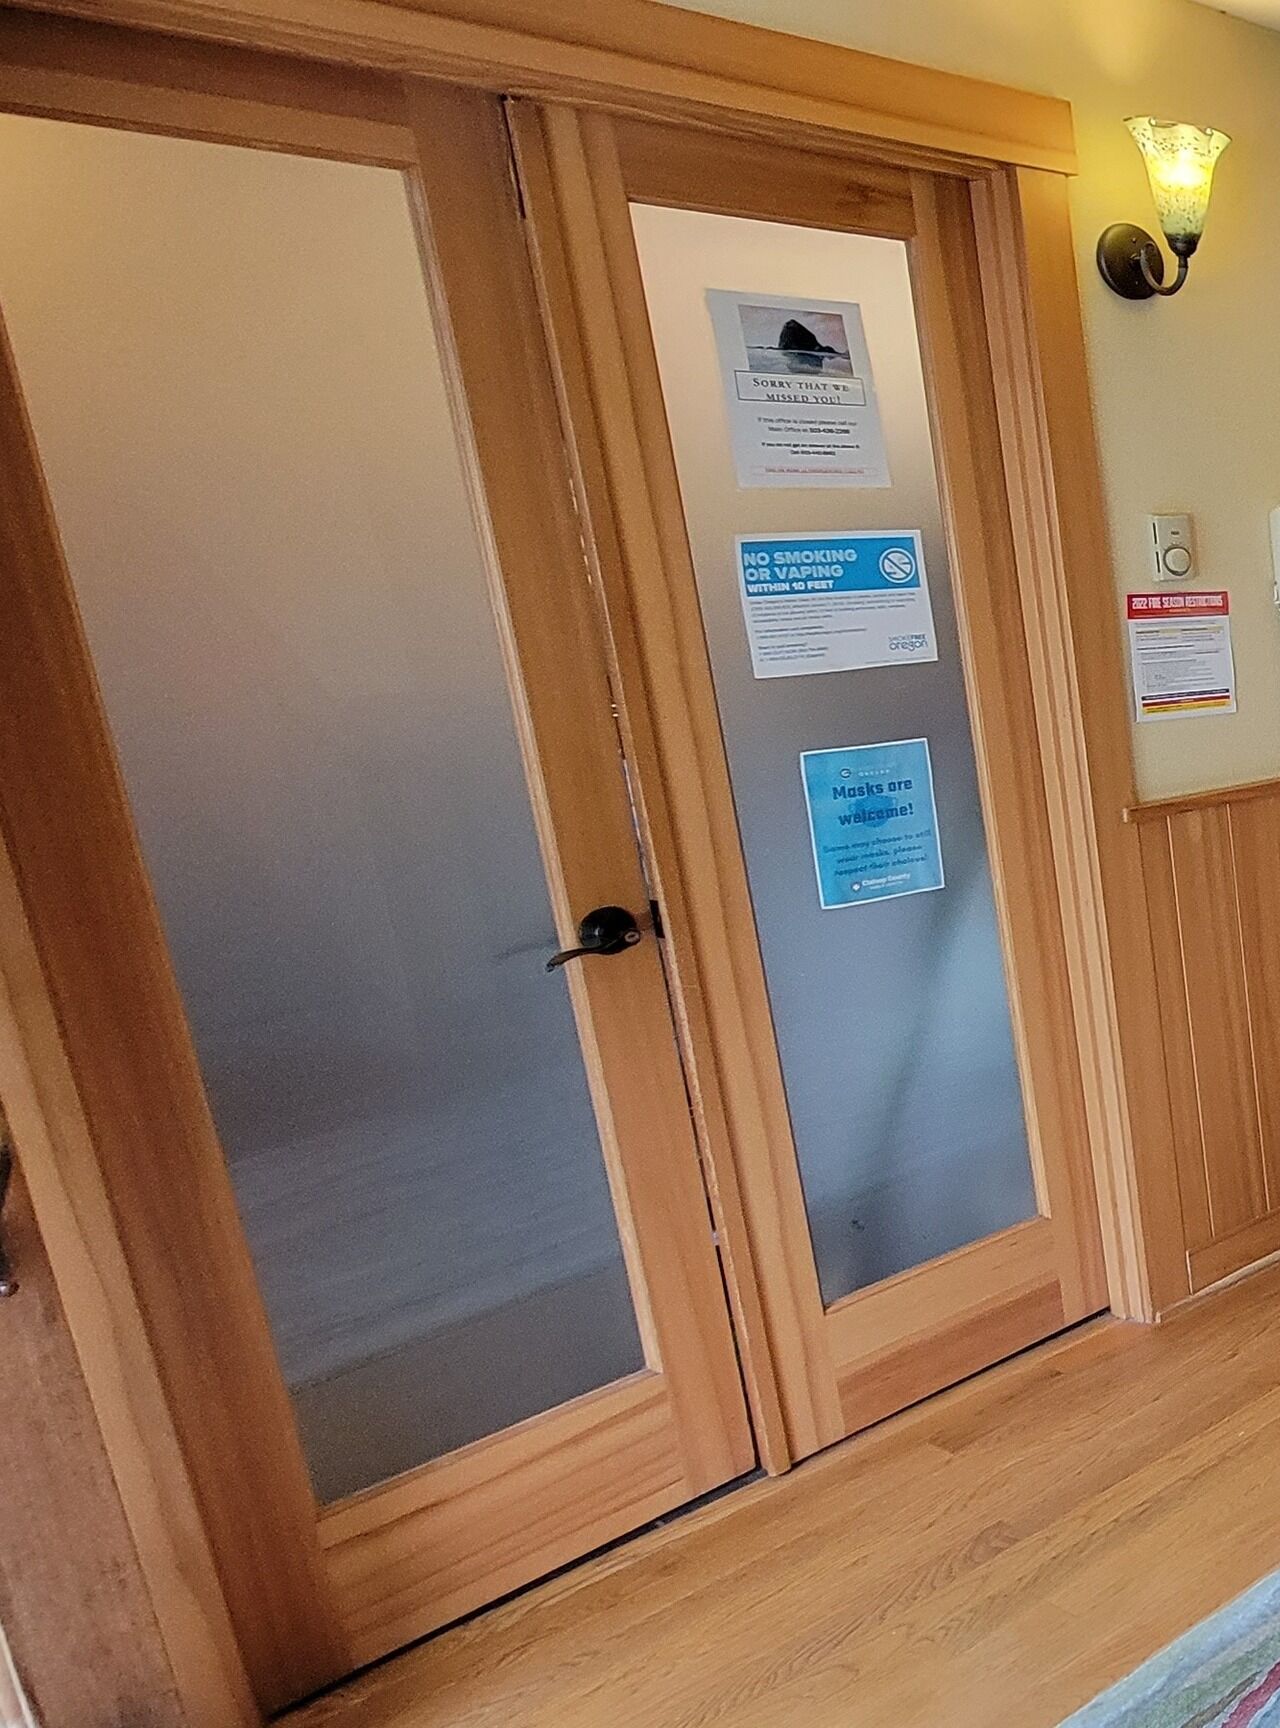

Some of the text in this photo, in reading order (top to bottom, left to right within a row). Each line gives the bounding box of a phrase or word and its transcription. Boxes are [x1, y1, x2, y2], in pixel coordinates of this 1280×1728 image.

[753, 377, 850, 392] SORRY THAT WE
[766, 393, 841, 404] MISSED YOU!
[743, 549, 858, 566] NO SMOKING
[745, 564, 844, 581] OR VAPING
[747, 580, 834, 593] WITHIN 10 FEET
[1132, 597, 1148, 609] 2022
[889, 640, 928, 651] oregon
[832, 779, 913, 800] Masks are
[838, 802, 914, 826] welcome!
